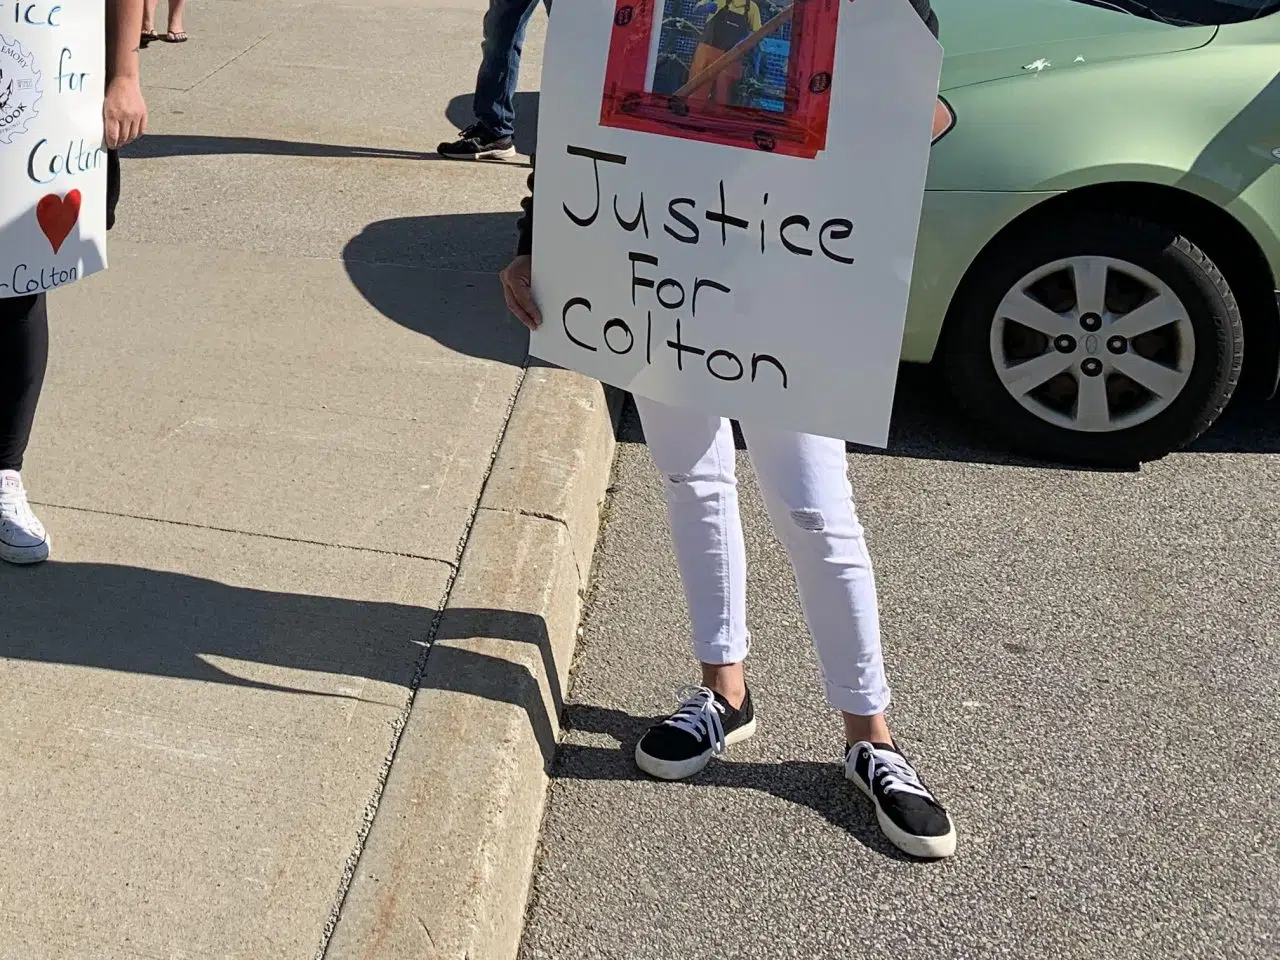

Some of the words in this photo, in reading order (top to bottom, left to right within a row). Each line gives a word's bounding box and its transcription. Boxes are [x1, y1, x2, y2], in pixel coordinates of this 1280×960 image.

[53, 47, 91, 95] for
[562, 144, 855, 265] Justice
[628, 251, 731, 318] For
[562, 296, 788, 390] Colton
